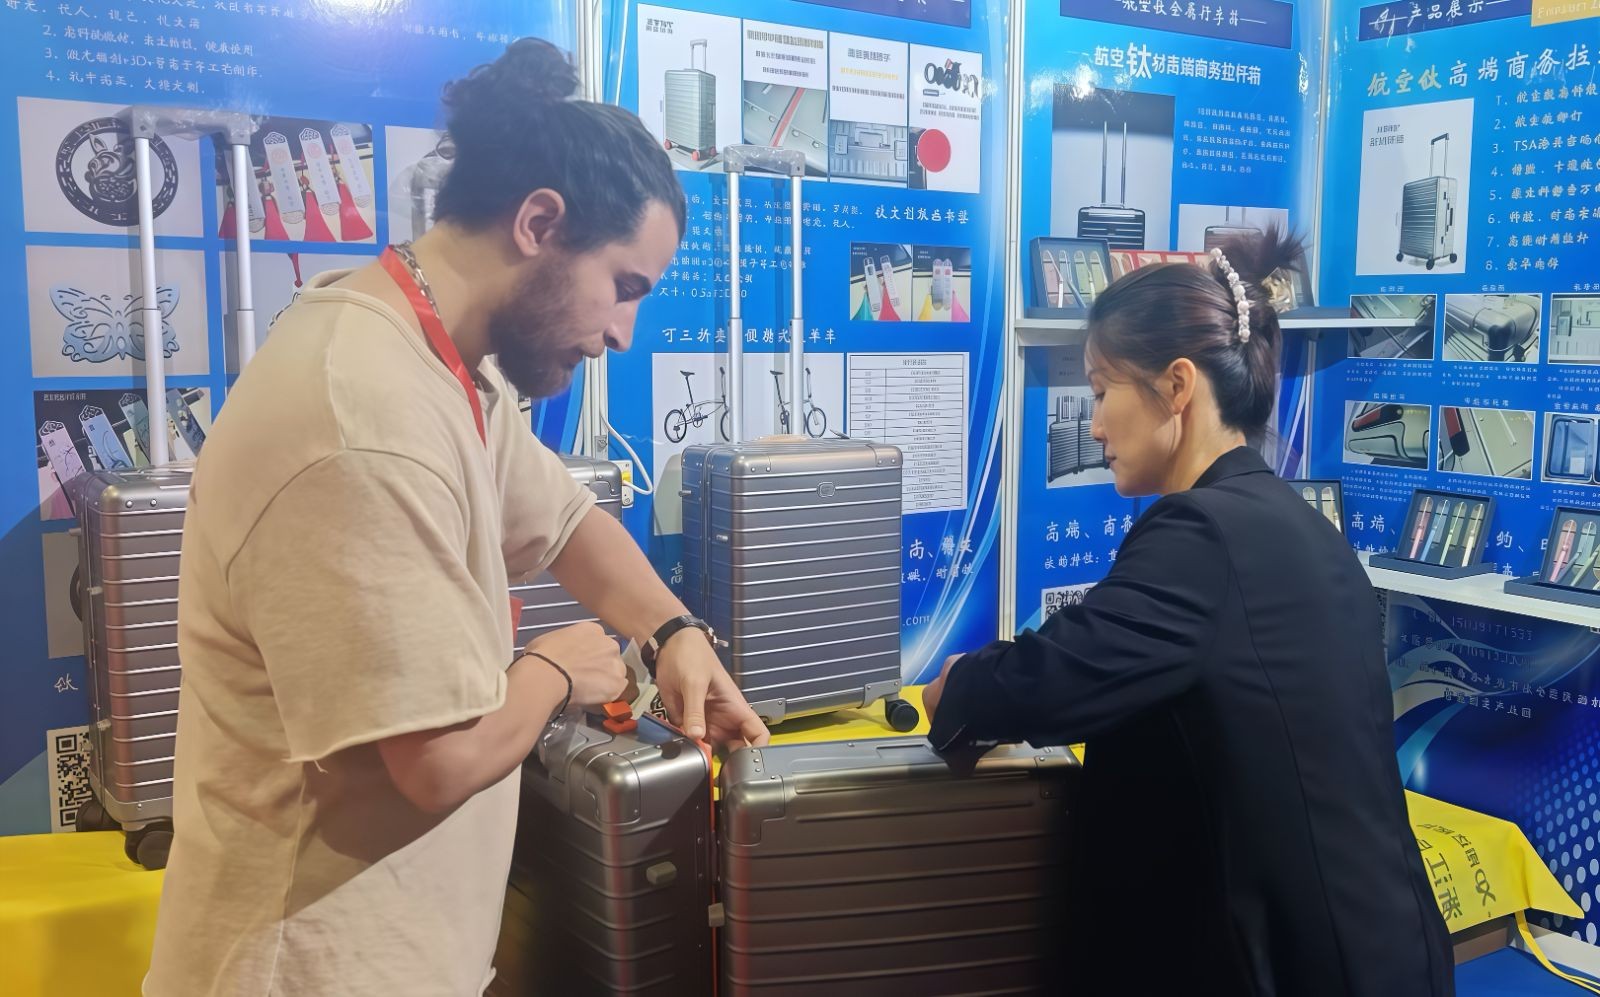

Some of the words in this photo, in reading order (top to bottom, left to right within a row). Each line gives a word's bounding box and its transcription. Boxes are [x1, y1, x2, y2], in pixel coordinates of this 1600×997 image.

[1367, 43, 1600, 97] 航空钛高端商务拉
